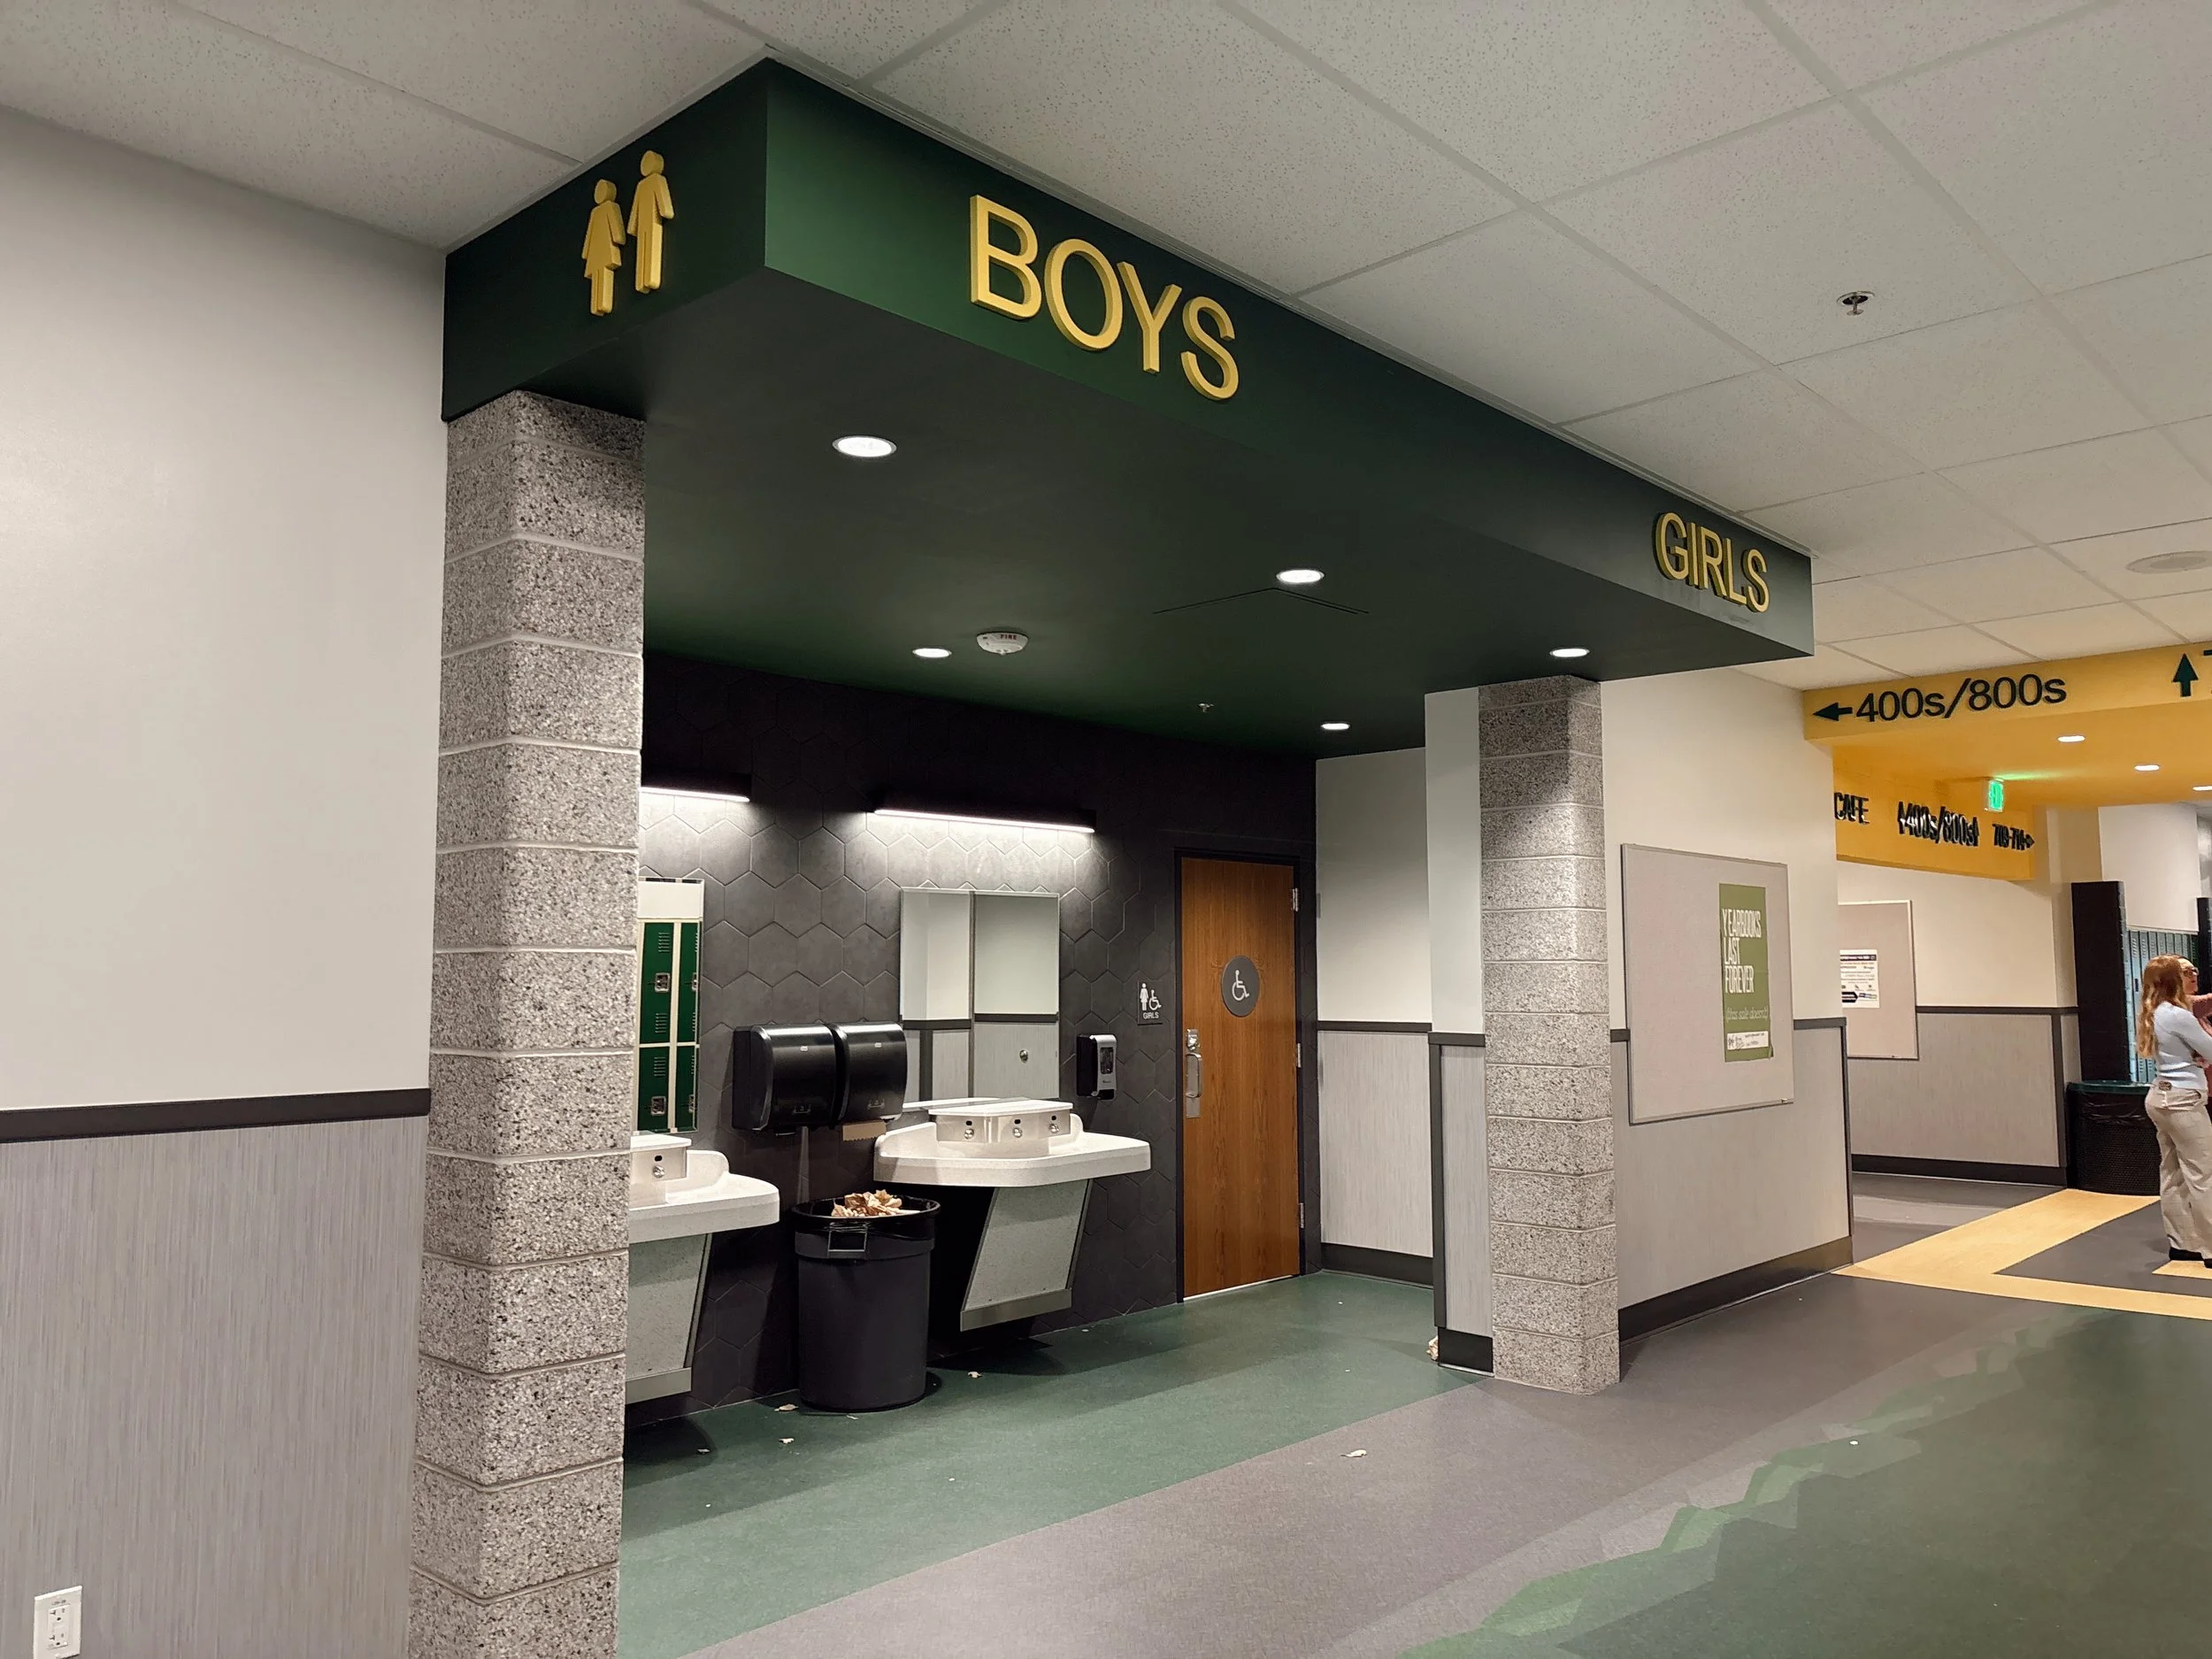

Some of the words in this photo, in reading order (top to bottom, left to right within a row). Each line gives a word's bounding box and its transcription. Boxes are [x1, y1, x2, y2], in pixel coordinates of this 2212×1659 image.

[969, 195, 1240, 401] BOYS
[1655, 512, 1770, 613] GIRLS
[1855, 673, 2067, 722] 400s/800s
[1833, 792, 1870, 824] CAFE
[1722, 909, 1762, 938] YEARBOOKS
[1724, 938, 1741, 964] LAST
[1724, 965, 1755, 993] FOREVER
[1142, 1011, 1160, 1020] GIRLS
